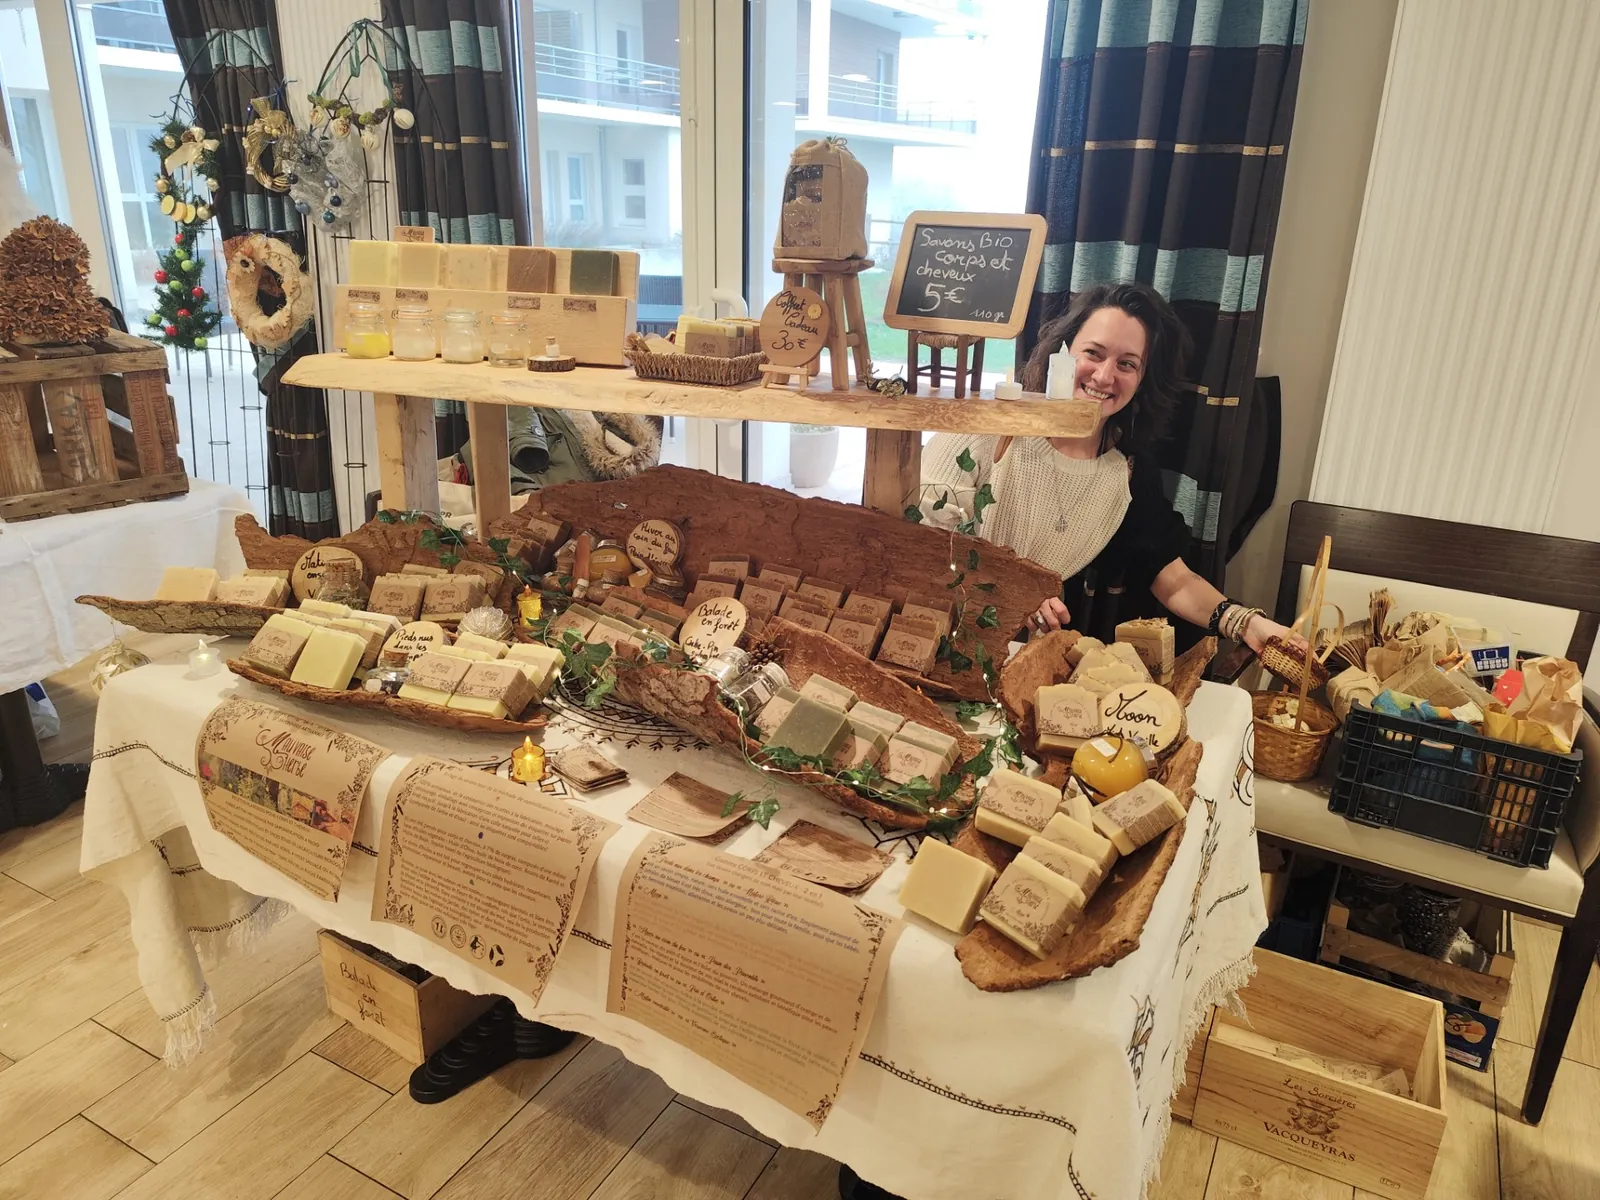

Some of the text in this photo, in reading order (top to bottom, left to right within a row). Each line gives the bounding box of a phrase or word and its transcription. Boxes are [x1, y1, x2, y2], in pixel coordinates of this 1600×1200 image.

[920, 228, 975, 251] Savons
[917, 260, 976, 282] cheveux
[935, 250, 1014, 272] Corps et
[775, 291, 806, 315] Coffret
[917, 282, 965, 312] 5€
[785, 312, 818, 335] Cadeau
[698, 603, 732, 618] Balade
[395, 630, 433, 643] Pieds nus
[701, 618, 740, 633] en forêt
[393, 640, 427, 651] dans les
[1105, 690, 1161, 726] Moon
[255, 728, 317, 761] Mauvaise
[1283, 1077, 1304, 1092] Les
[1308, 1087, 1357, 1109] Sorcières
[1263, 1121, 1356, 1162] VACQUEYRAS
